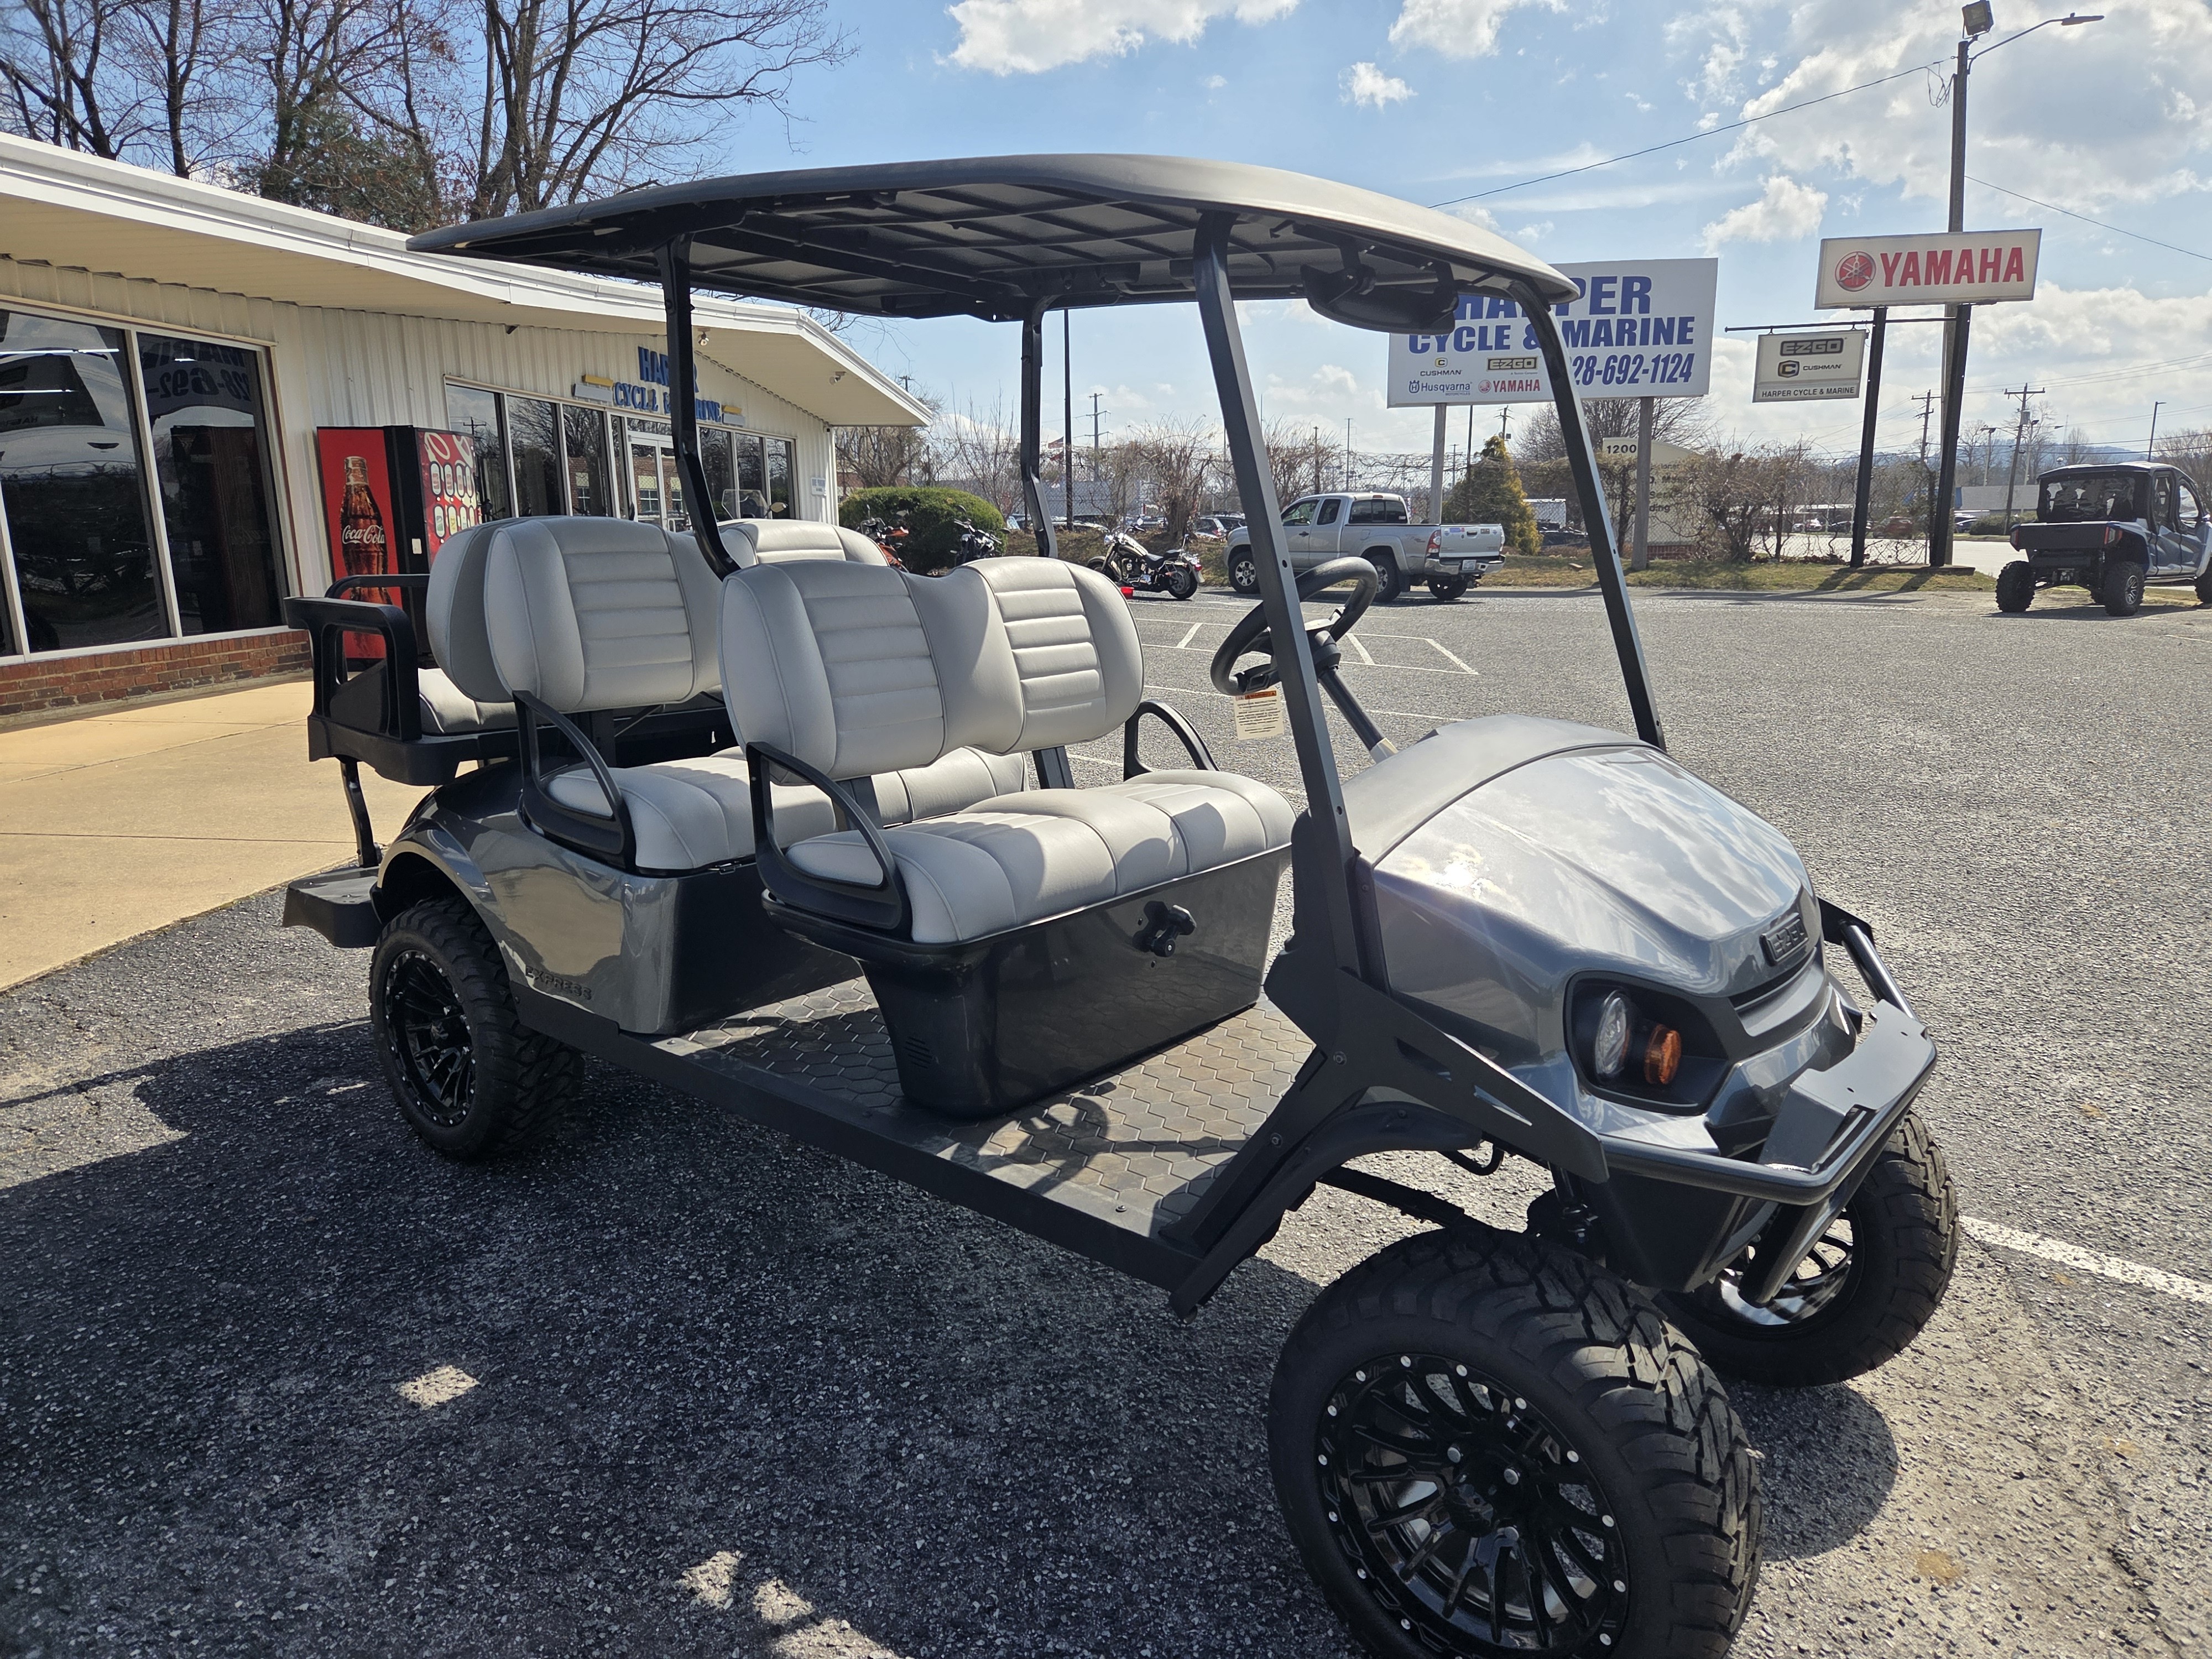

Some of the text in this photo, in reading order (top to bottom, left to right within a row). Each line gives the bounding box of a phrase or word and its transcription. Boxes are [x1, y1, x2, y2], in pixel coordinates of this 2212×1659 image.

[1880, 247, 2024, 287] YAMAHA
[1409, 326, 1511, 354] CYCLE
[1562, 316, 1695, 348] MARINE
[1782, 340, 1841, 355] EZGO
[1490, 358, 1535, 369] EZGO
[1571, 353, 1695, 385] 28-692-1124
[1421, 382, 1470, 393] Husqvarna
[1493, 379, 1541, 393] YAMAHA
[1762, 389, 1791, 398] HARPER
[1606, 444, 1637, 454] 1200
[342, 524, 385, 545] Coca-Cola
[525, 966, 592, 1000] EXPRESS
